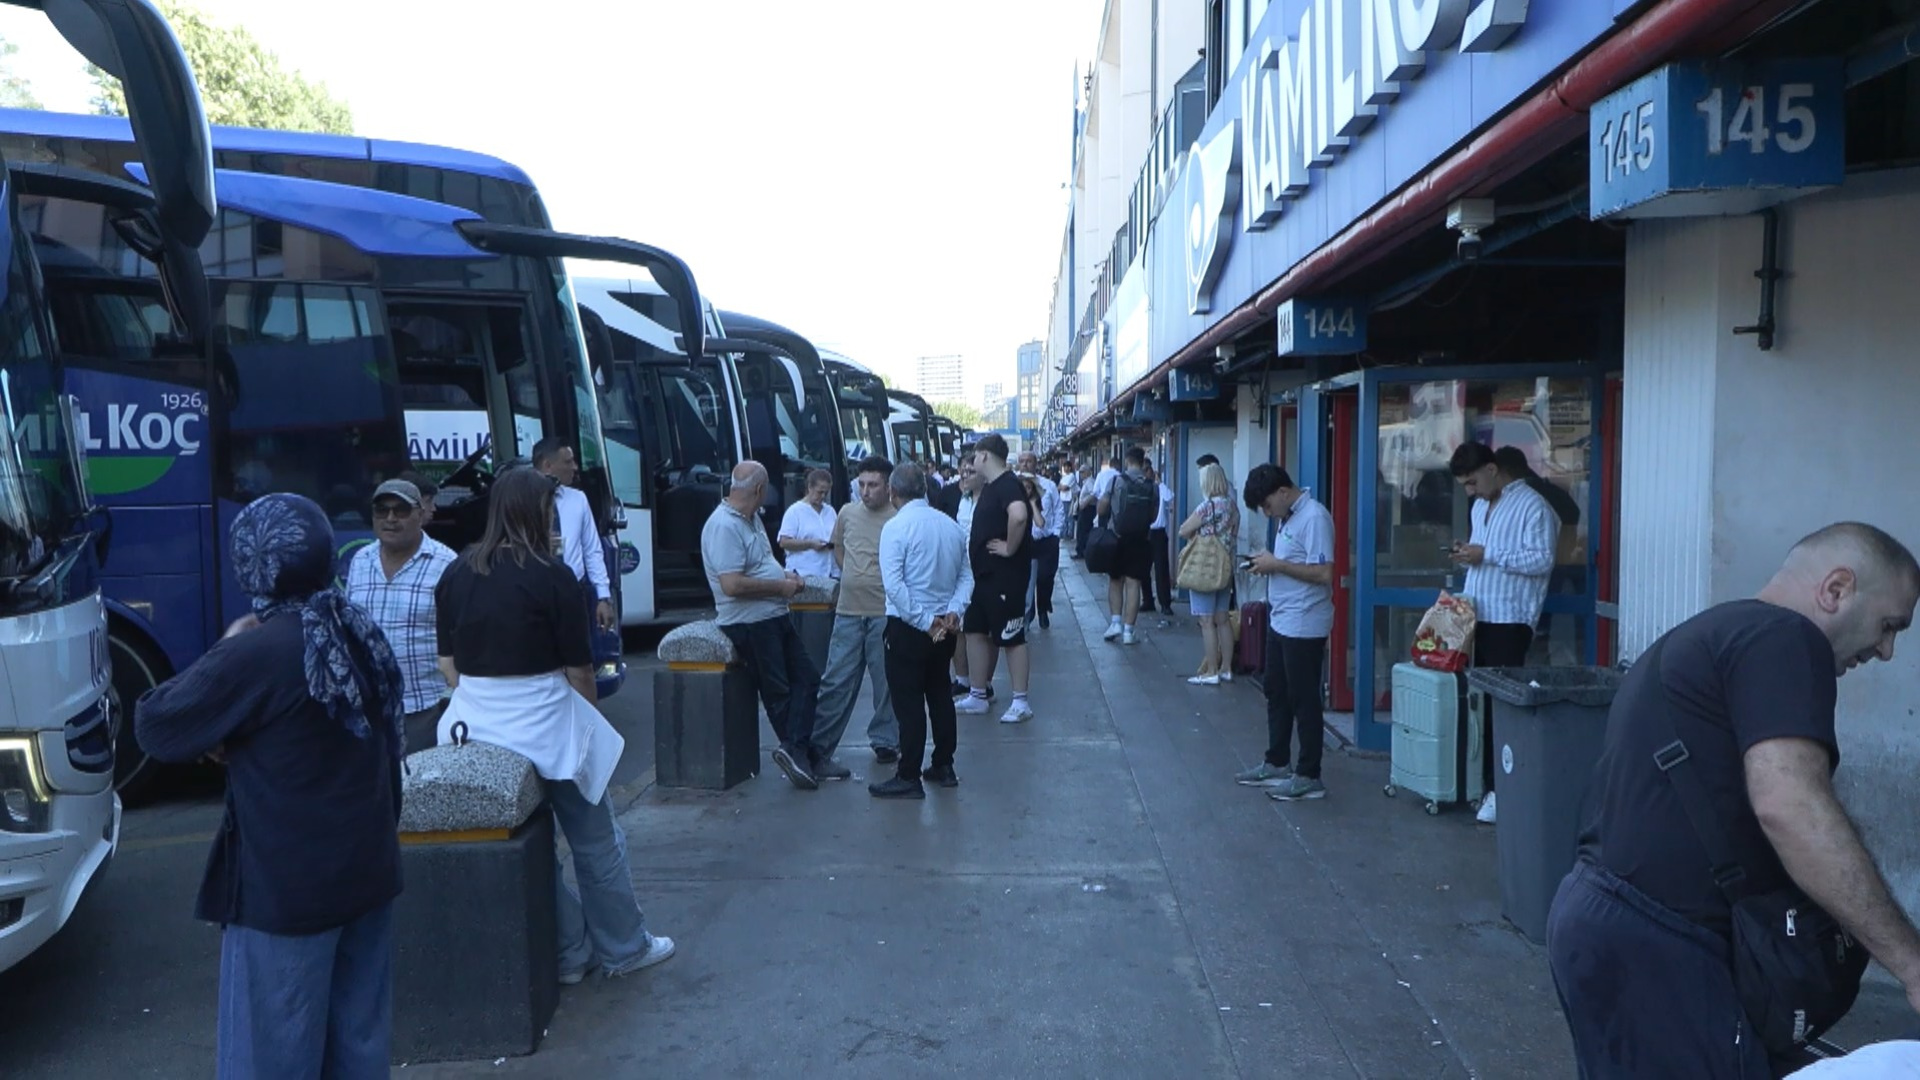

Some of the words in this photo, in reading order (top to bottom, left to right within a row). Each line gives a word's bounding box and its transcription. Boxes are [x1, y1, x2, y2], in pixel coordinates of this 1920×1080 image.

[1696, 83, 1816, 155] 145
[1600, 101, 1655, 184] 145
[1304, 307, 1356, 339] 144
[1063, 374, 1077, 393] 138
[1183, 373, 1214, 392] 143
[160, 392, 202, 409] 1926
[1063, 407, 1077, 425] 139
